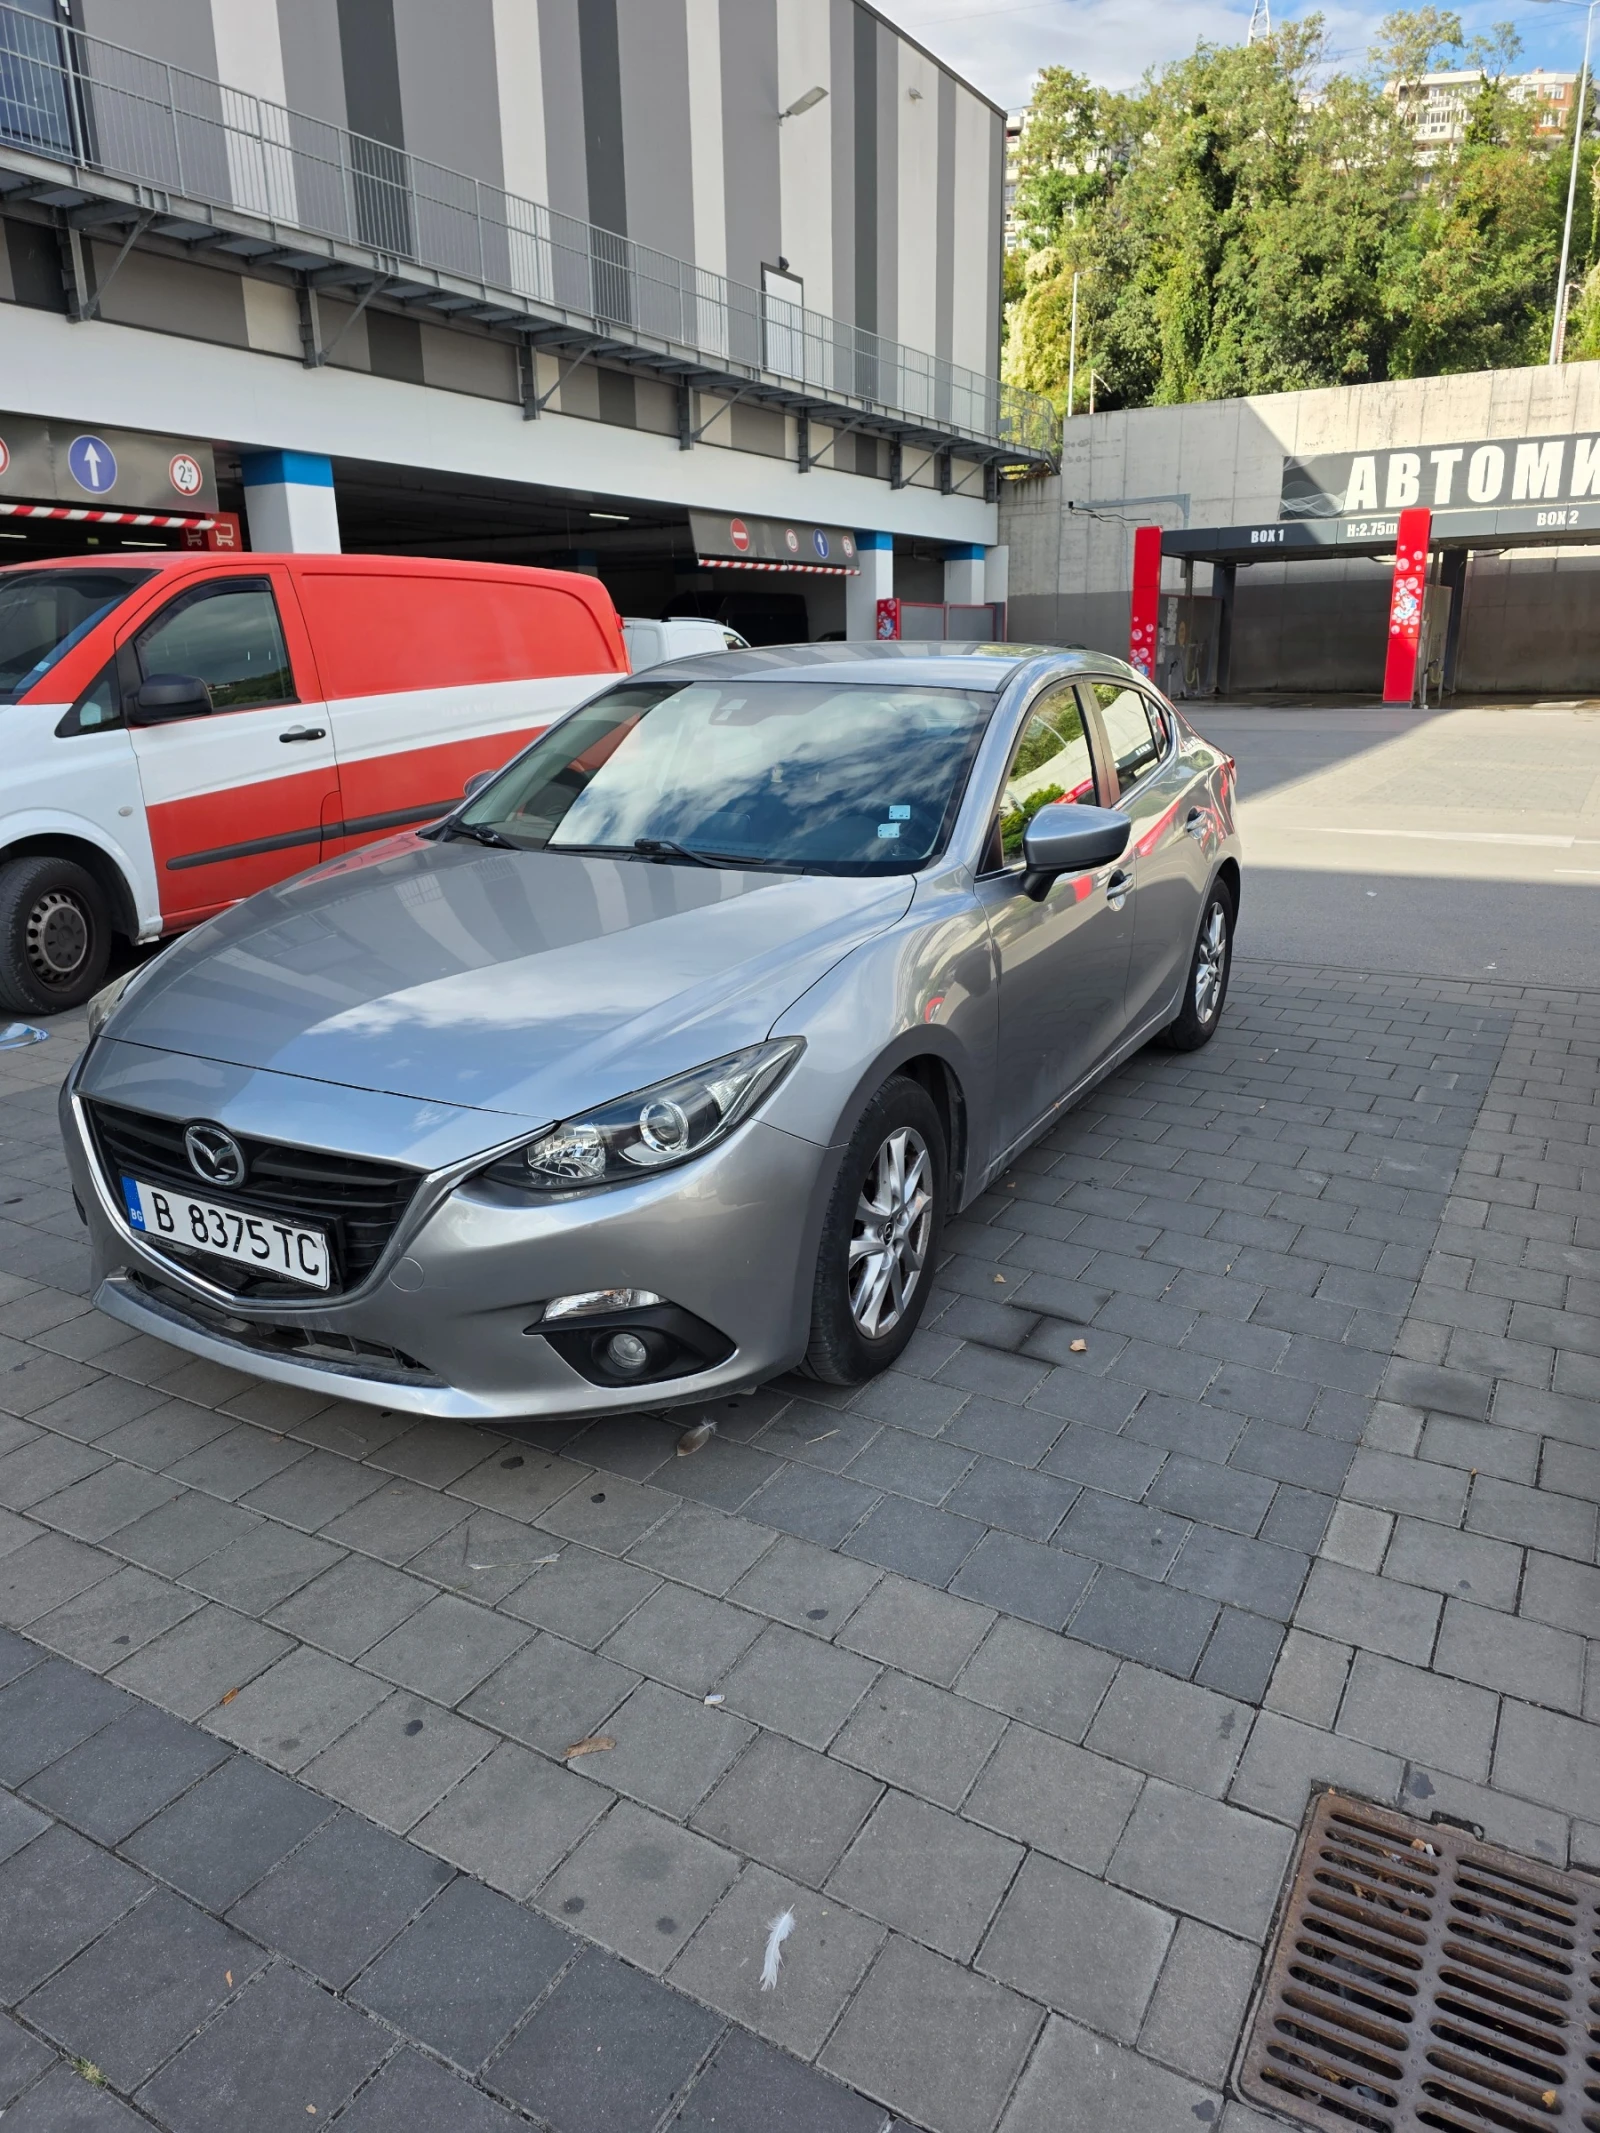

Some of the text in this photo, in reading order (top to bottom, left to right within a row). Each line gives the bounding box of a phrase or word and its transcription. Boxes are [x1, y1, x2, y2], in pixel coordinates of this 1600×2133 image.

[1536, 509, 1579, 527] BOX 2
[1250, 528, 1285, 543] BOX 1
[130, 1207, 143, 1222] BG
[151, 1191, 175, 1233] B
